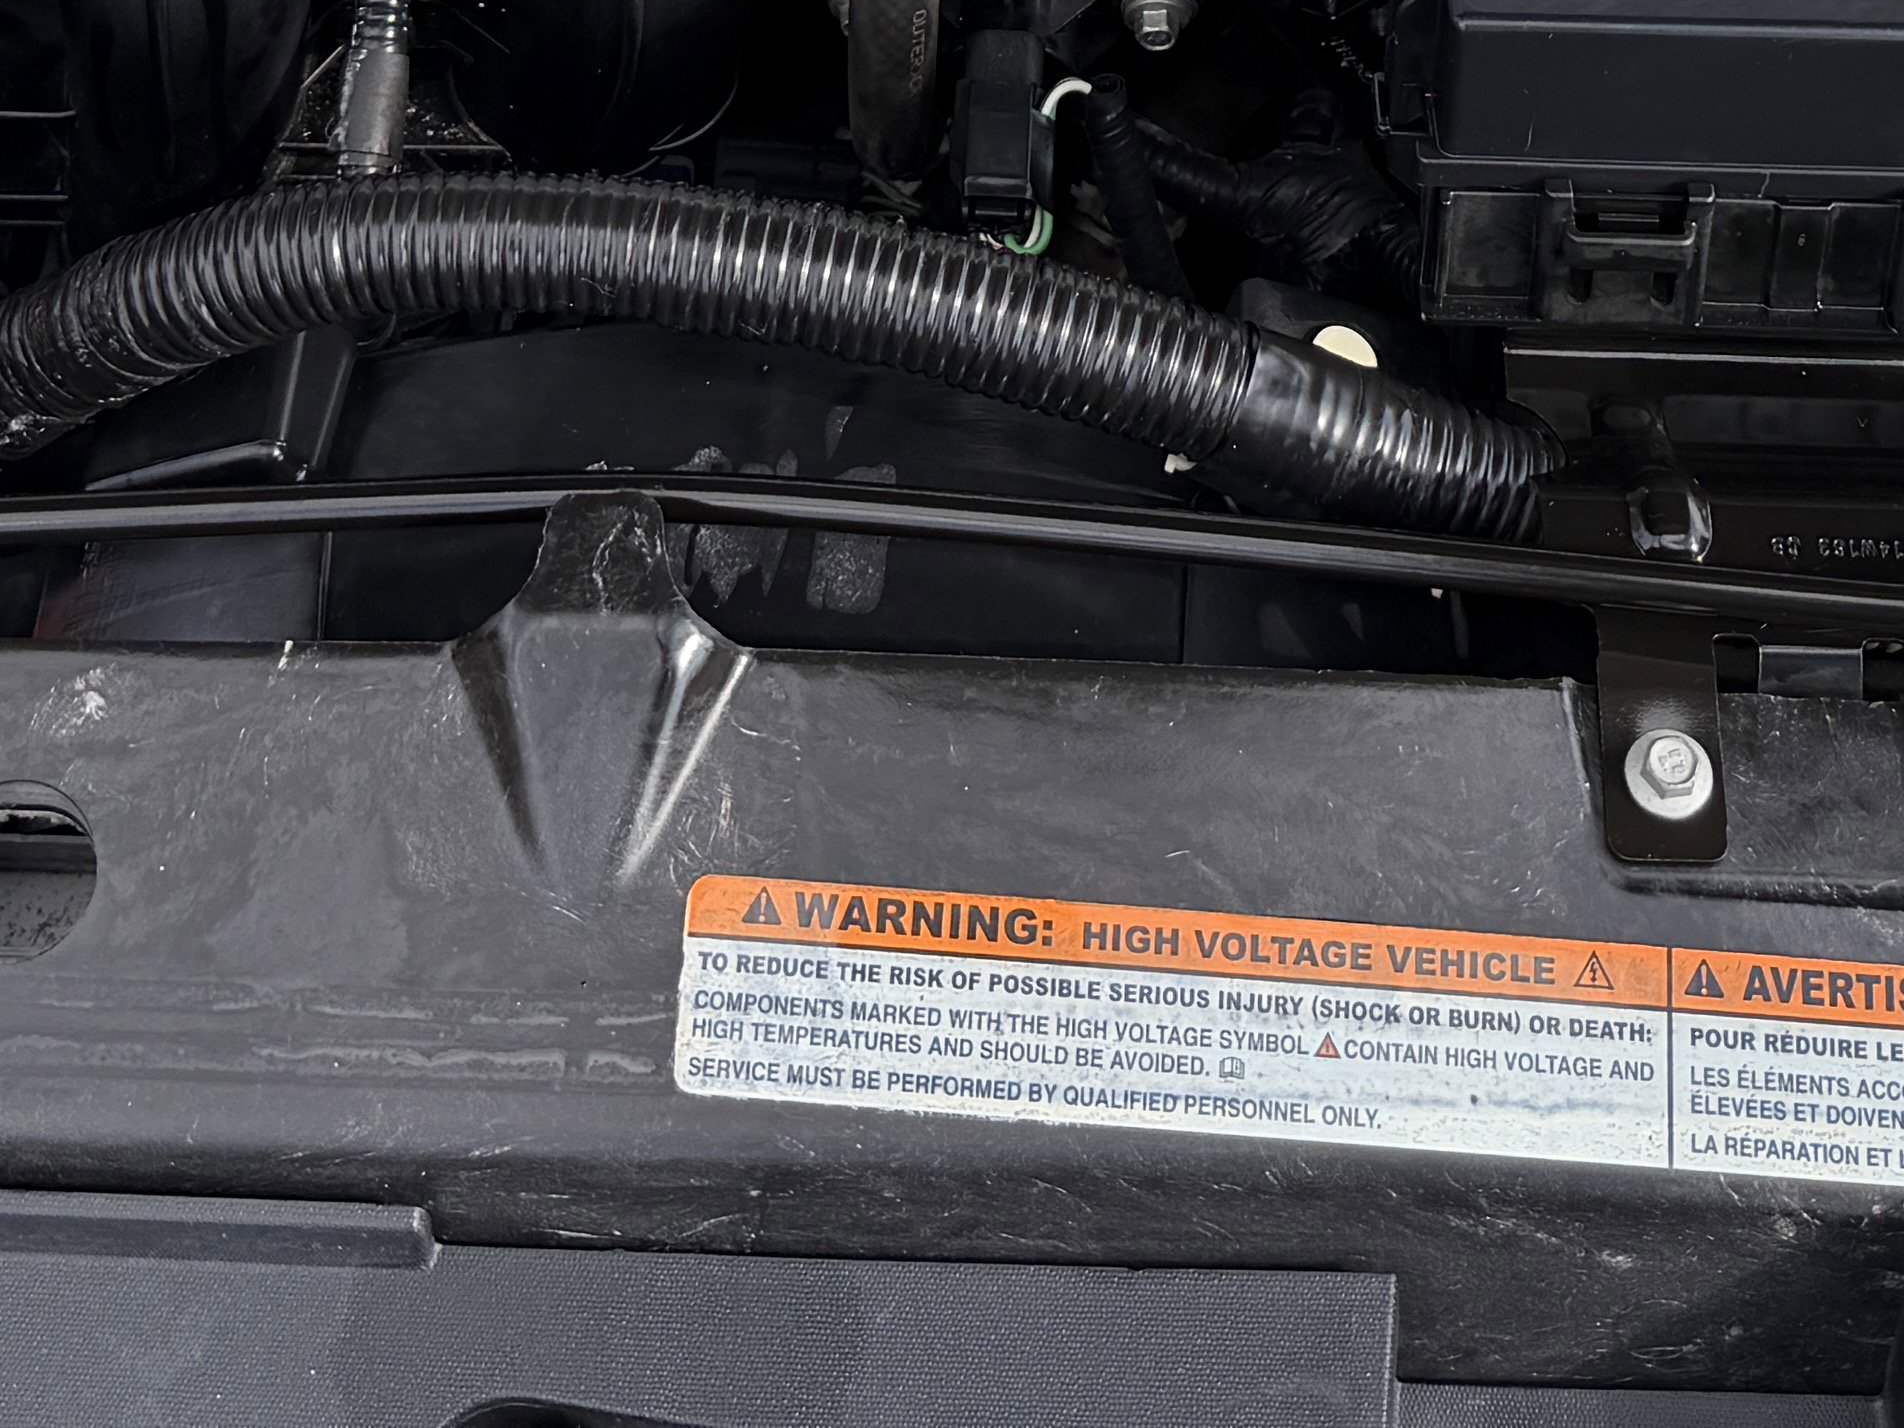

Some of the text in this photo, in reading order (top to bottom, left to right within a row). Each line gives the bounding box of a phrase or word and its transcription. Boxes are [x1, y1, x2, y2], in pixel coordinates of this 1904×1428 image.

[794, 890, 1556, 986] WARNING: HIGH VOLTAGE VEHICLE
[697, 950, 1653, 1047] TO REDUCE THE RISK OF POSSIBLE SERIOUS INJURY (SHOCK OR BURN) OR DEATH:
